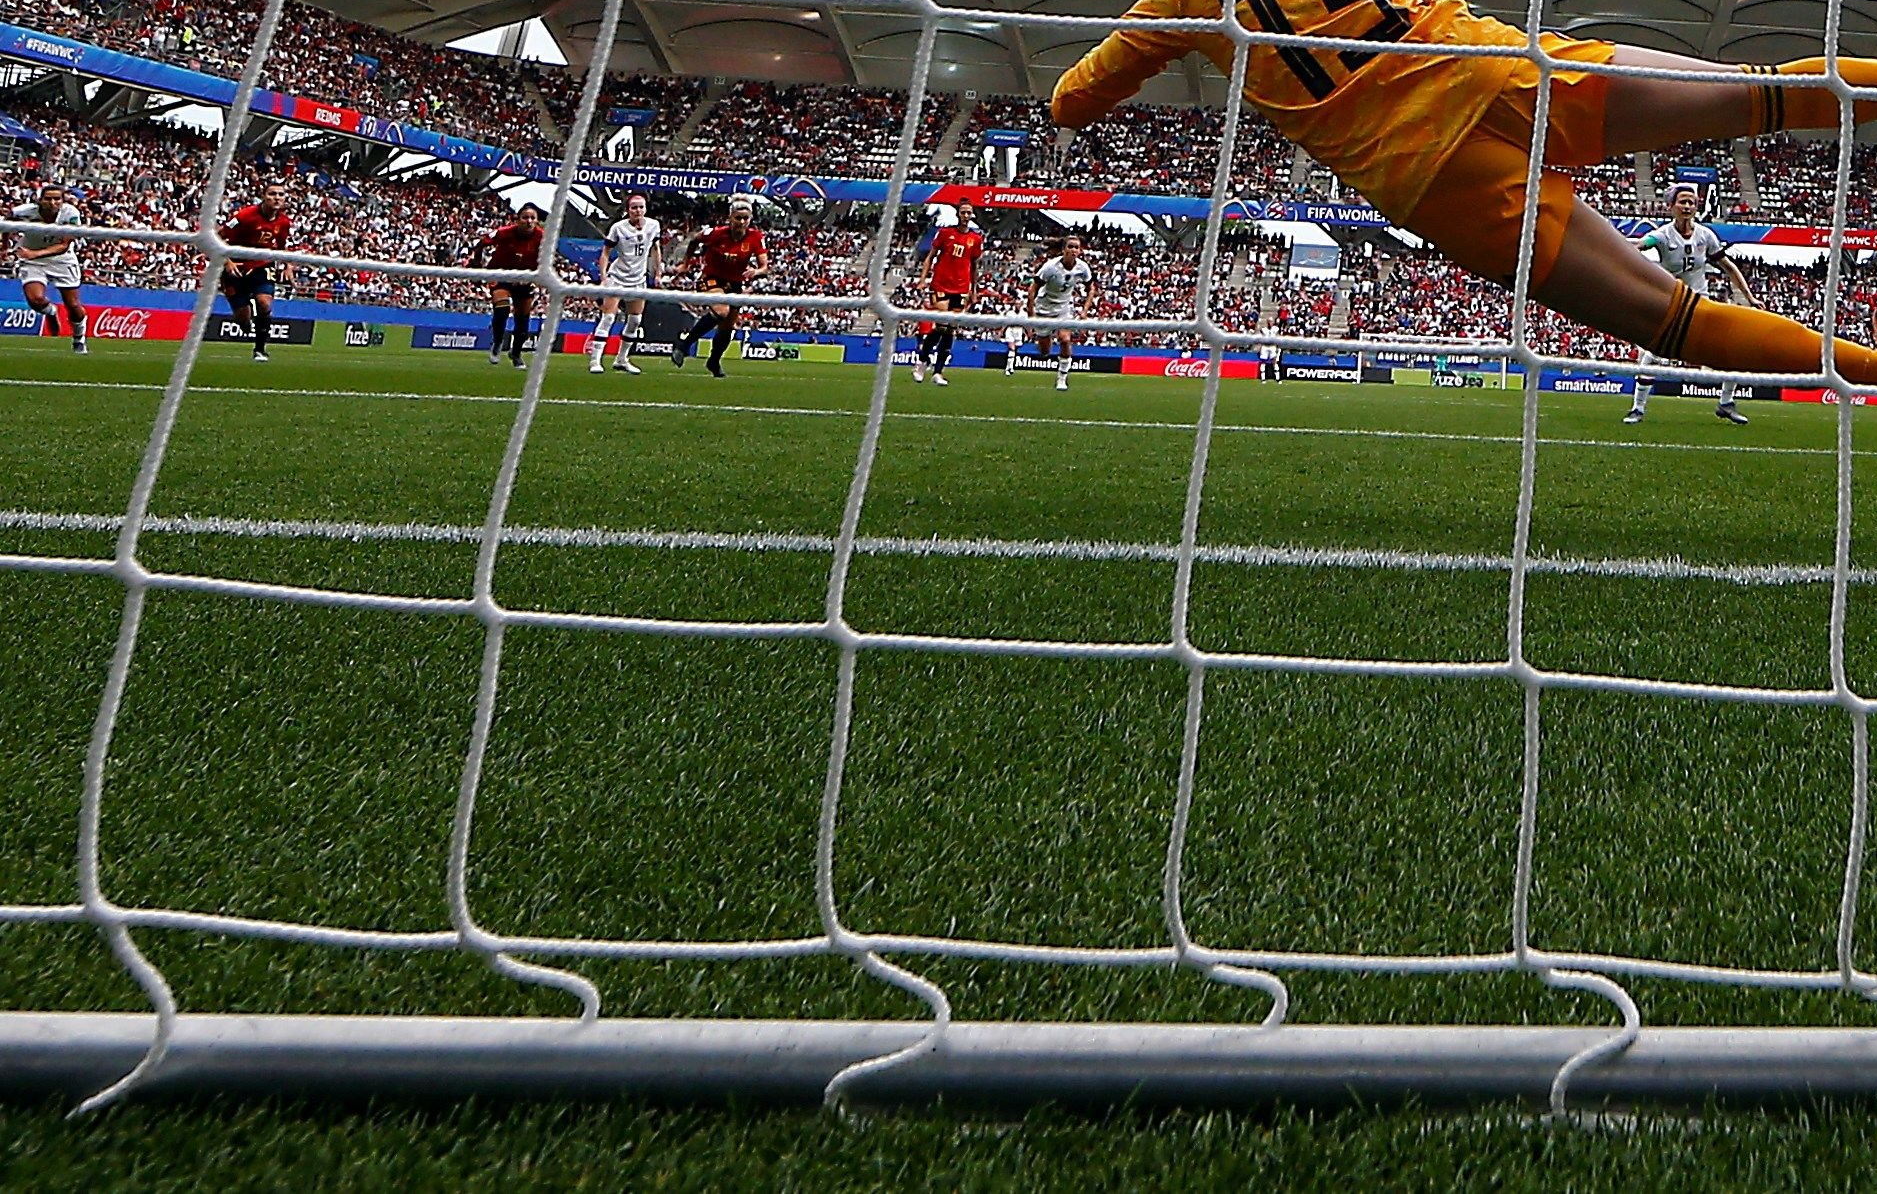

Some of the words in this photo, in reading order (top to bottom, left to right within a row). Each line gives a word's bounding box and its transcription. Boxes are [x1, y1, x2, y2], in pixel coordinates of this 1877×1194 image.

[315, 108, 342, 126] REIMS
[637, 173, 656, 186] DE
[659, 176, 718, 189] BRILLER
[995, 193, 1048, 204] #FIFAWWC
[1307, 207, 1334, 219] FIFA
[953, 244, 964, 257] 10
[4, 308, 36, 329] 2019
[1014, 356, 1059, 368] Minute
[1554, 379, 1623, 394] smartwater
[1681, 383, 1722, 397] Minute
